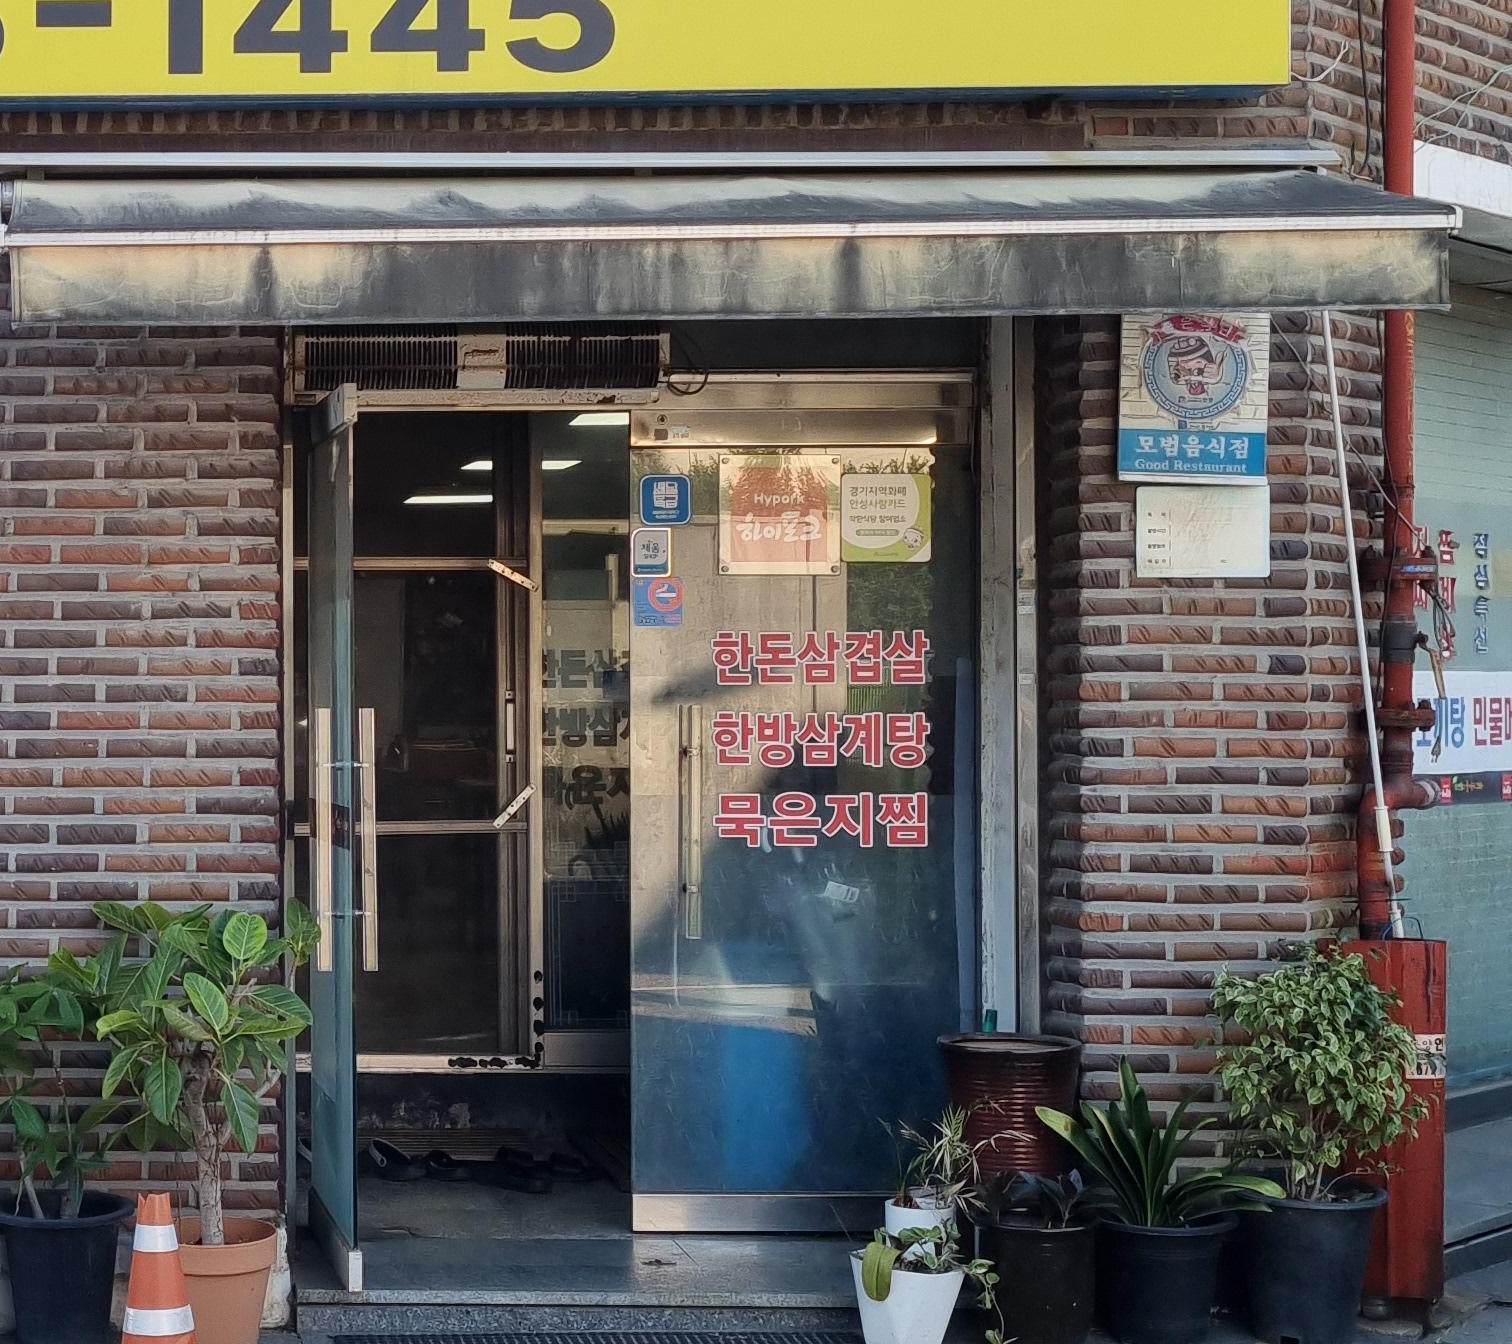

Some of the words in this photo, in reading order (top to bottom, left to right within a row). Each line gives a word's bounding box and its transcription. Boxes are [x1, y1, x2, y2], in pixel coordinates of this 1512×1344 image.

[1135, 434, 1250, 459] 모범음식점
[1134, 458, 1170, 472] Good
[1173, 458, 1248, 474] Restaurant
[753, 493, 806, 508] Hypork
[735, 511, 823, 544] 하이포크
[711, 629, 931, 685] 한돈삼겹살
[712, 712, 931, 768] 한방삼계탕
[713, 791, 928, 848] 묵은지찜
